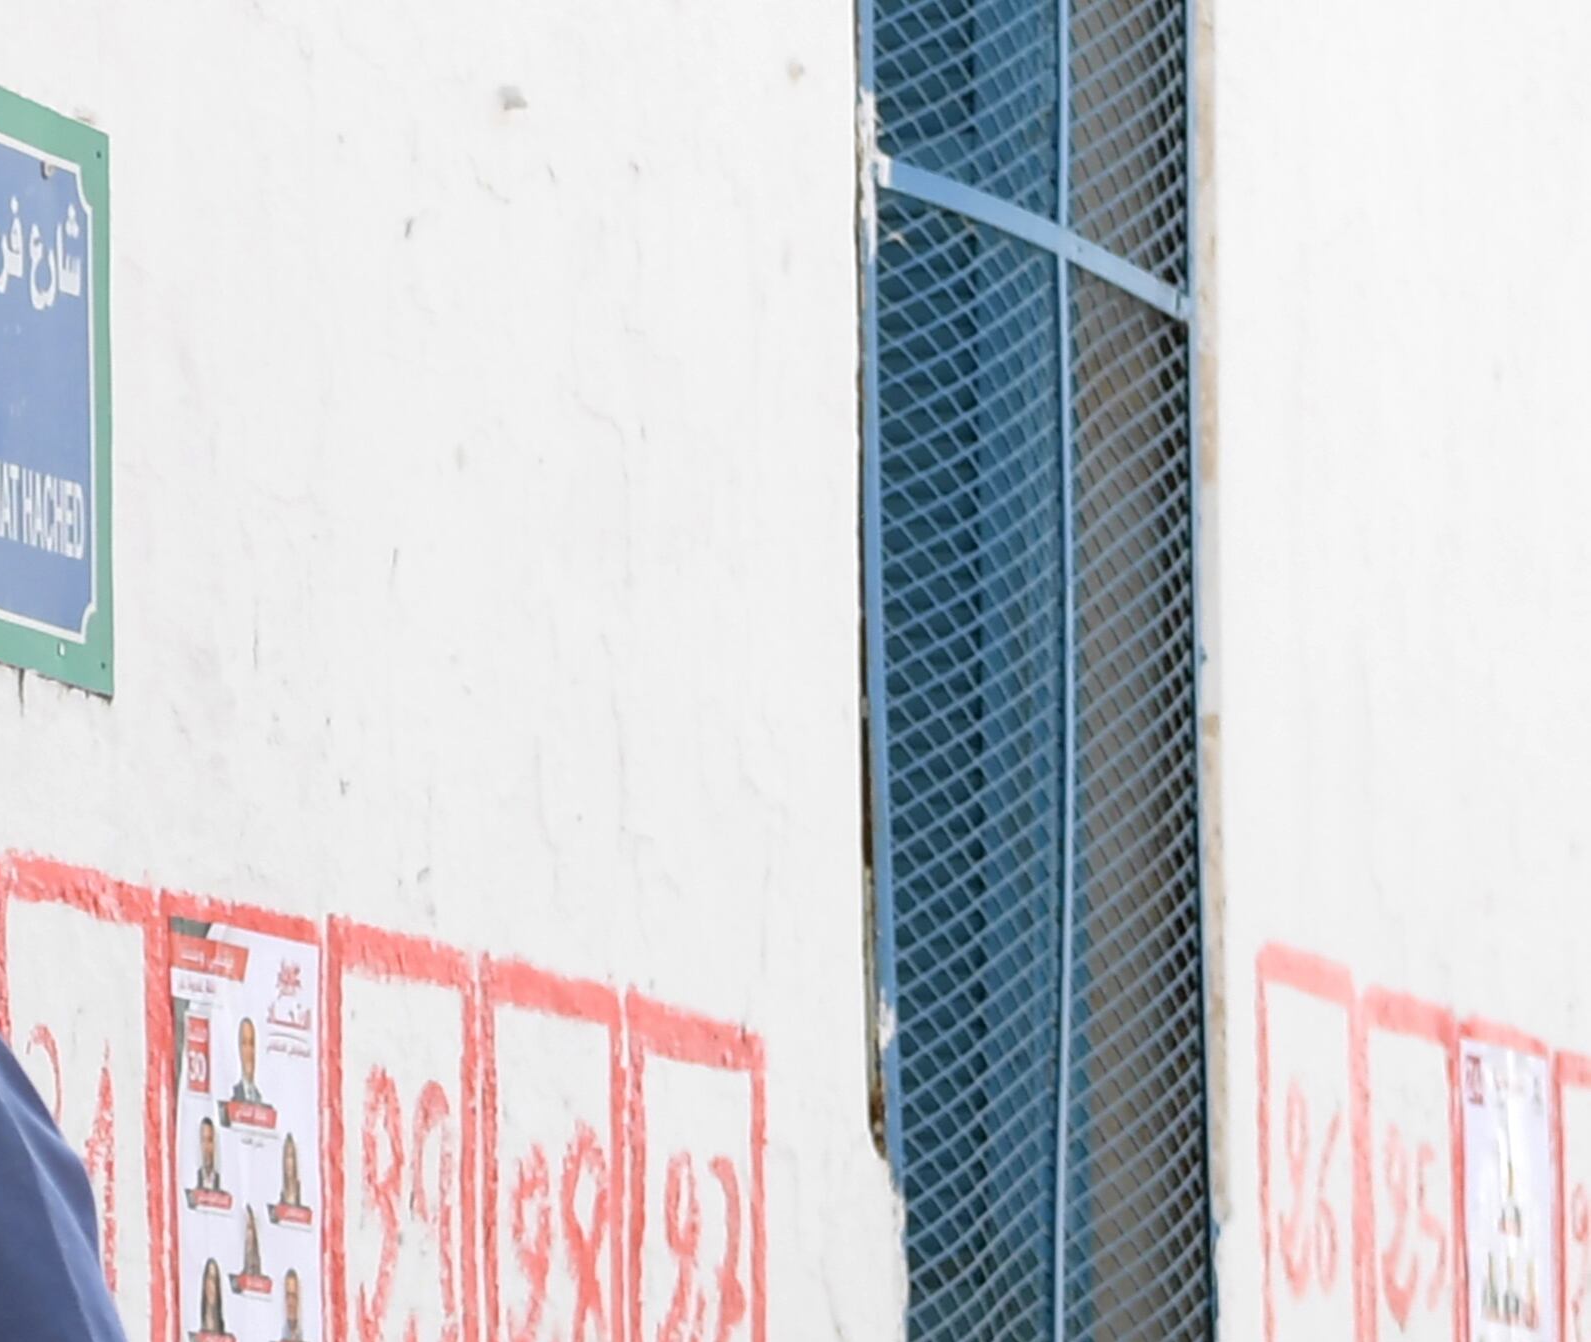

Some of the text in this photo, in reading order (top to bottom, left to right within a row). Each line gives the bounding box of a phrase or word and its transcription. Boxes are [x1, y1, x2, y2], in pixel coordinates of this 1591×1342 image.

[29, 203, 81, 310] شارع
[21, 466, 85, 560] HACHED
[1280, 1077, 1342, 1299] 26
